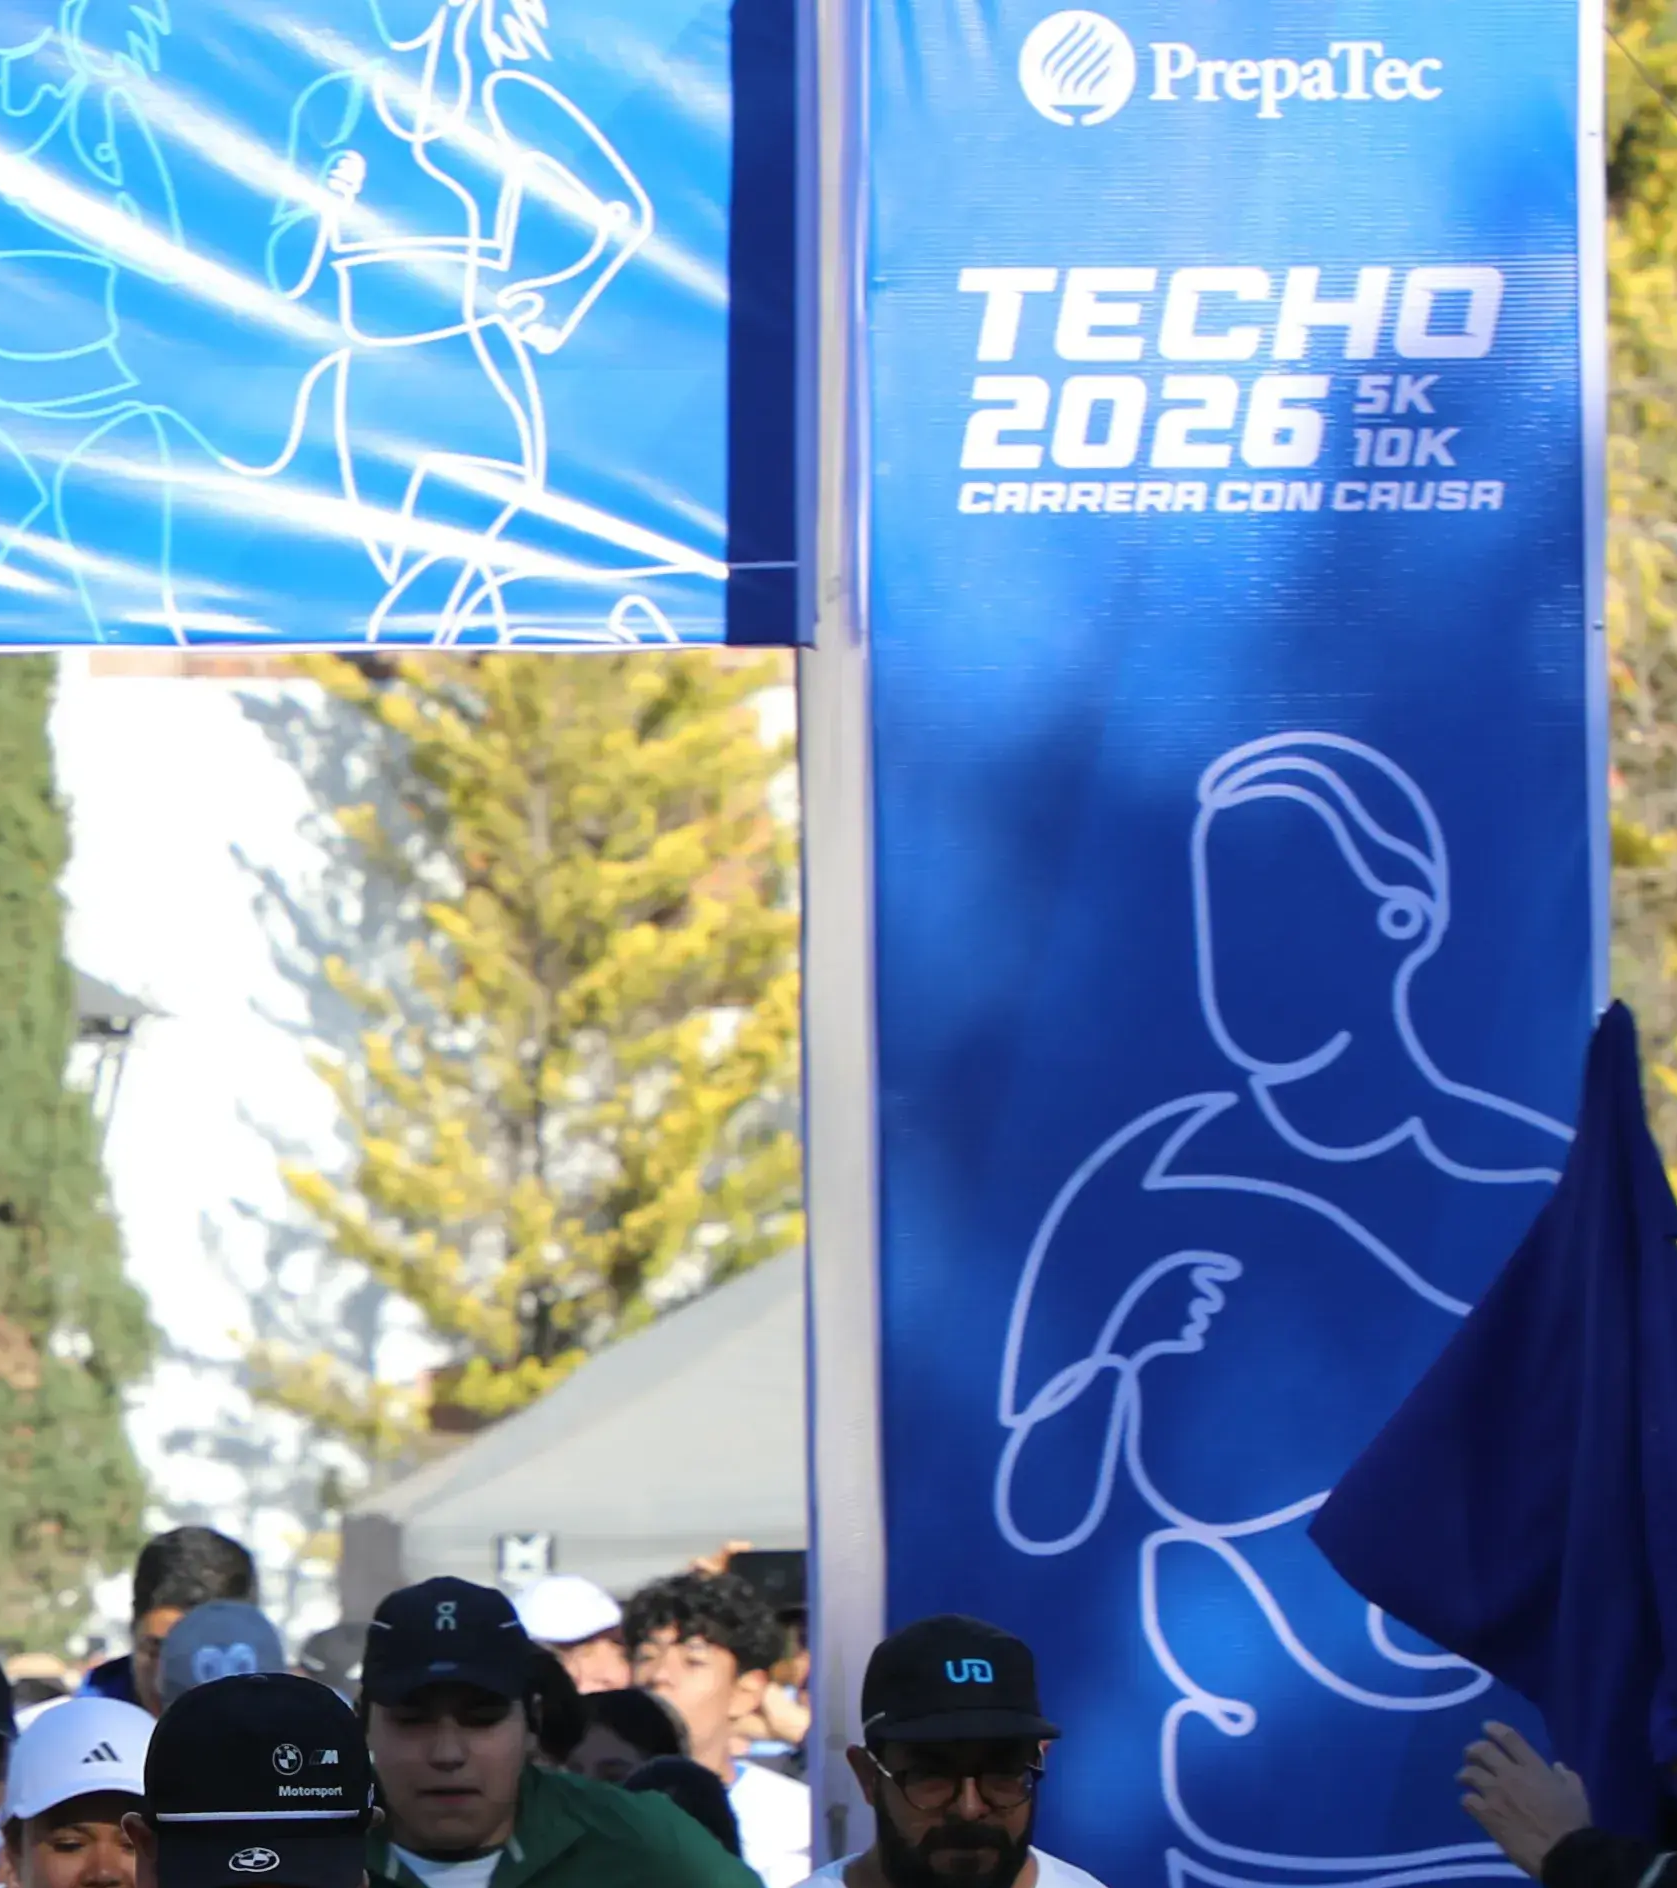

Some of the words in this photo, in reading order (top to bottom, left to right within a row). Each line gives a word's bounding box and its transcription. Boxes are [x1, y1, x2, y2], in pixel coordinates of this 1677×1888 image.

[1149, 41, 1443, 118] PrepaTec
[957, 266, 1504, 362] TECHO
[1353, 374, 1440, 414] 5K
[960, 375, 1329, 468] 2026
[1353, 427, 1461, 467] 10K
[958, 481, 1207, 514] CARRERA
[1214, 480, 1323, 513] CON
[1331, 479, 1505, 511] CAUSA
[278, 1785, 343, 1799] Motorsport
